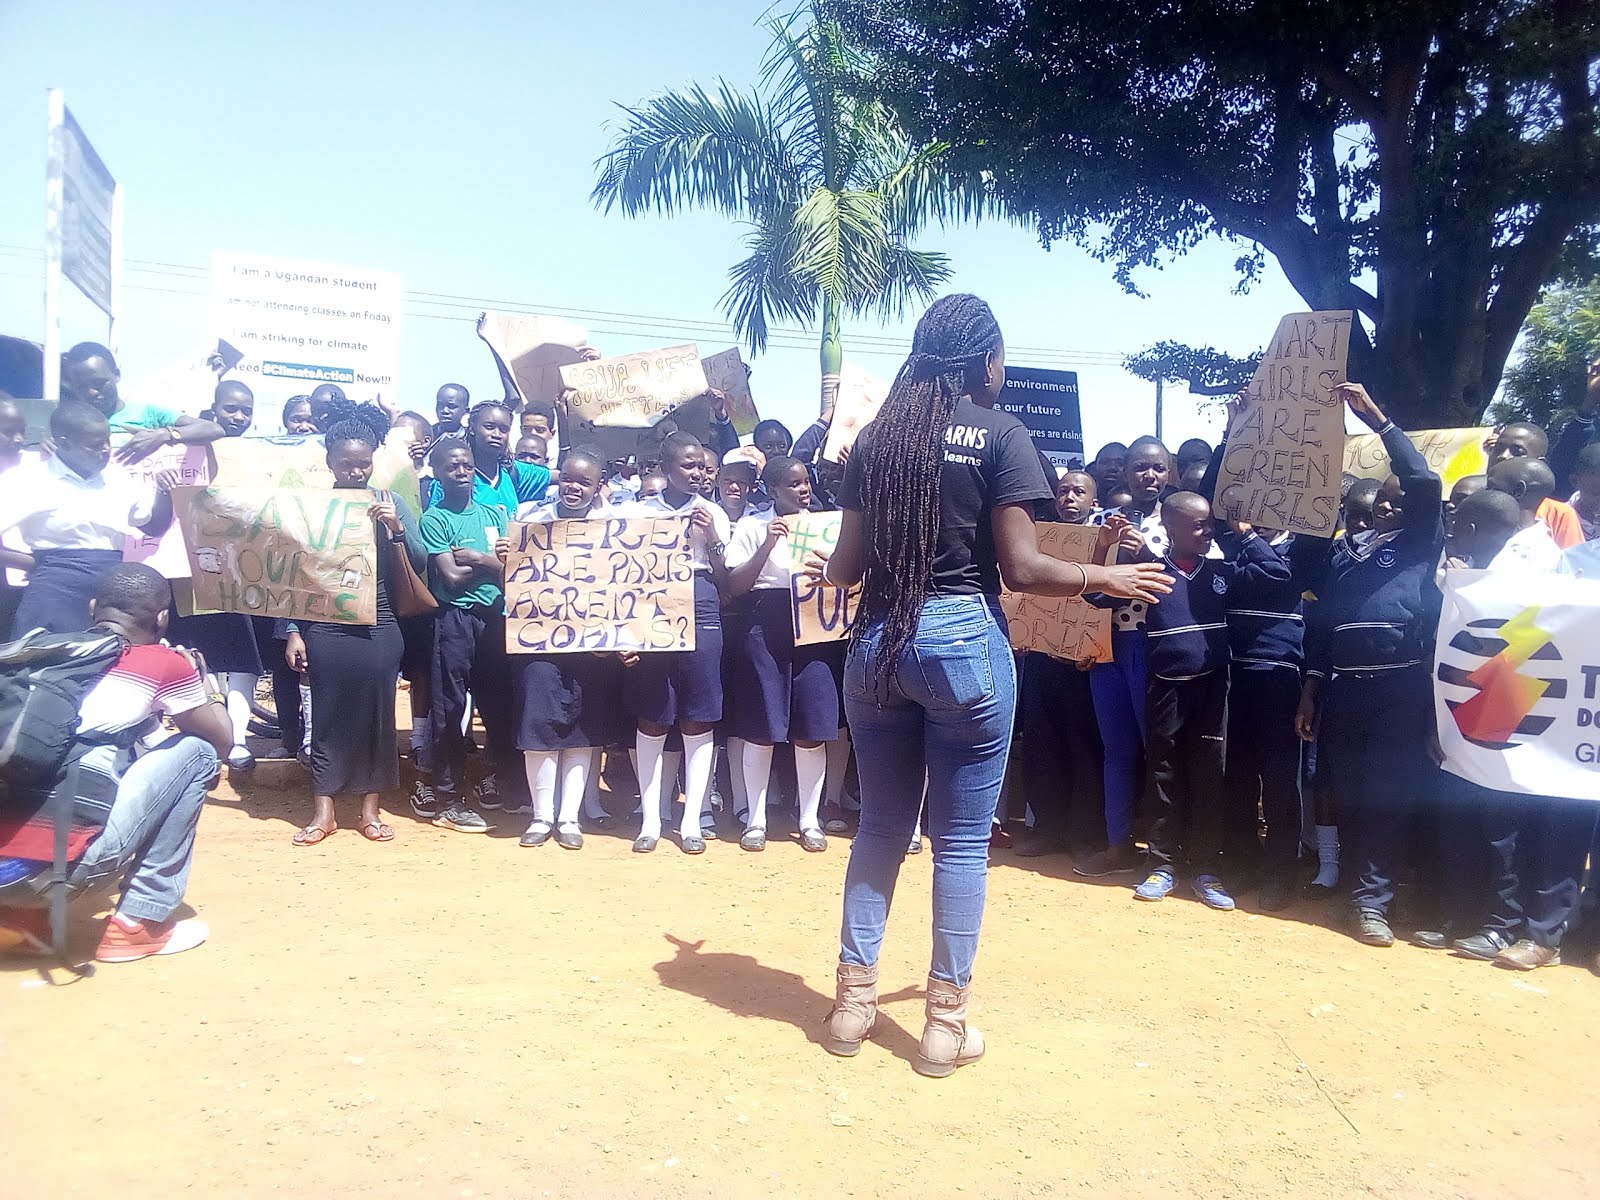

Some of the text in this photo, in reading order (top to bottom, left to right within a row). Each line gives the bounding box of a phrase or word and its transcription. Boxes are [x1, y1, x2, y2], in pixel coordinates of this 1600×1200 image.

[275, 271, 329, 285] Ugandan
[333, 277, 377, 291] student
[264, 301, 309, 316] attending
[312, 306, 347, 318] classes
[350, 311, 361, 319] on
[364, 310, 392, 325] Friday
[241, 331, 258, 340] am
[262, 333, 305, 347] striking
[308, 337, 323, 346] for
[327, 339, 369, 351] climate
[263, 362, 353, 383] #ClimateAction
[356, 374, 391, 385] Now!!!
[1006, 379, 1077, 393] environment
[1004, 404, 1025, 413] our
[1027, 403, 1062, 416] future
[1233, 406, 1322, 447] ARE
[1224, 443, 1331, 489] GREEN
[1219, 483, 1335, 531] GIRLS
[516, 516, 693, 553] WERE?
[238, 549, 315, 587] OUR
[506, 551, 692, 585] ARE PARIS
[219, 579, 358, 621] HOMES
[517, 616, 688, 651] GOALS?
